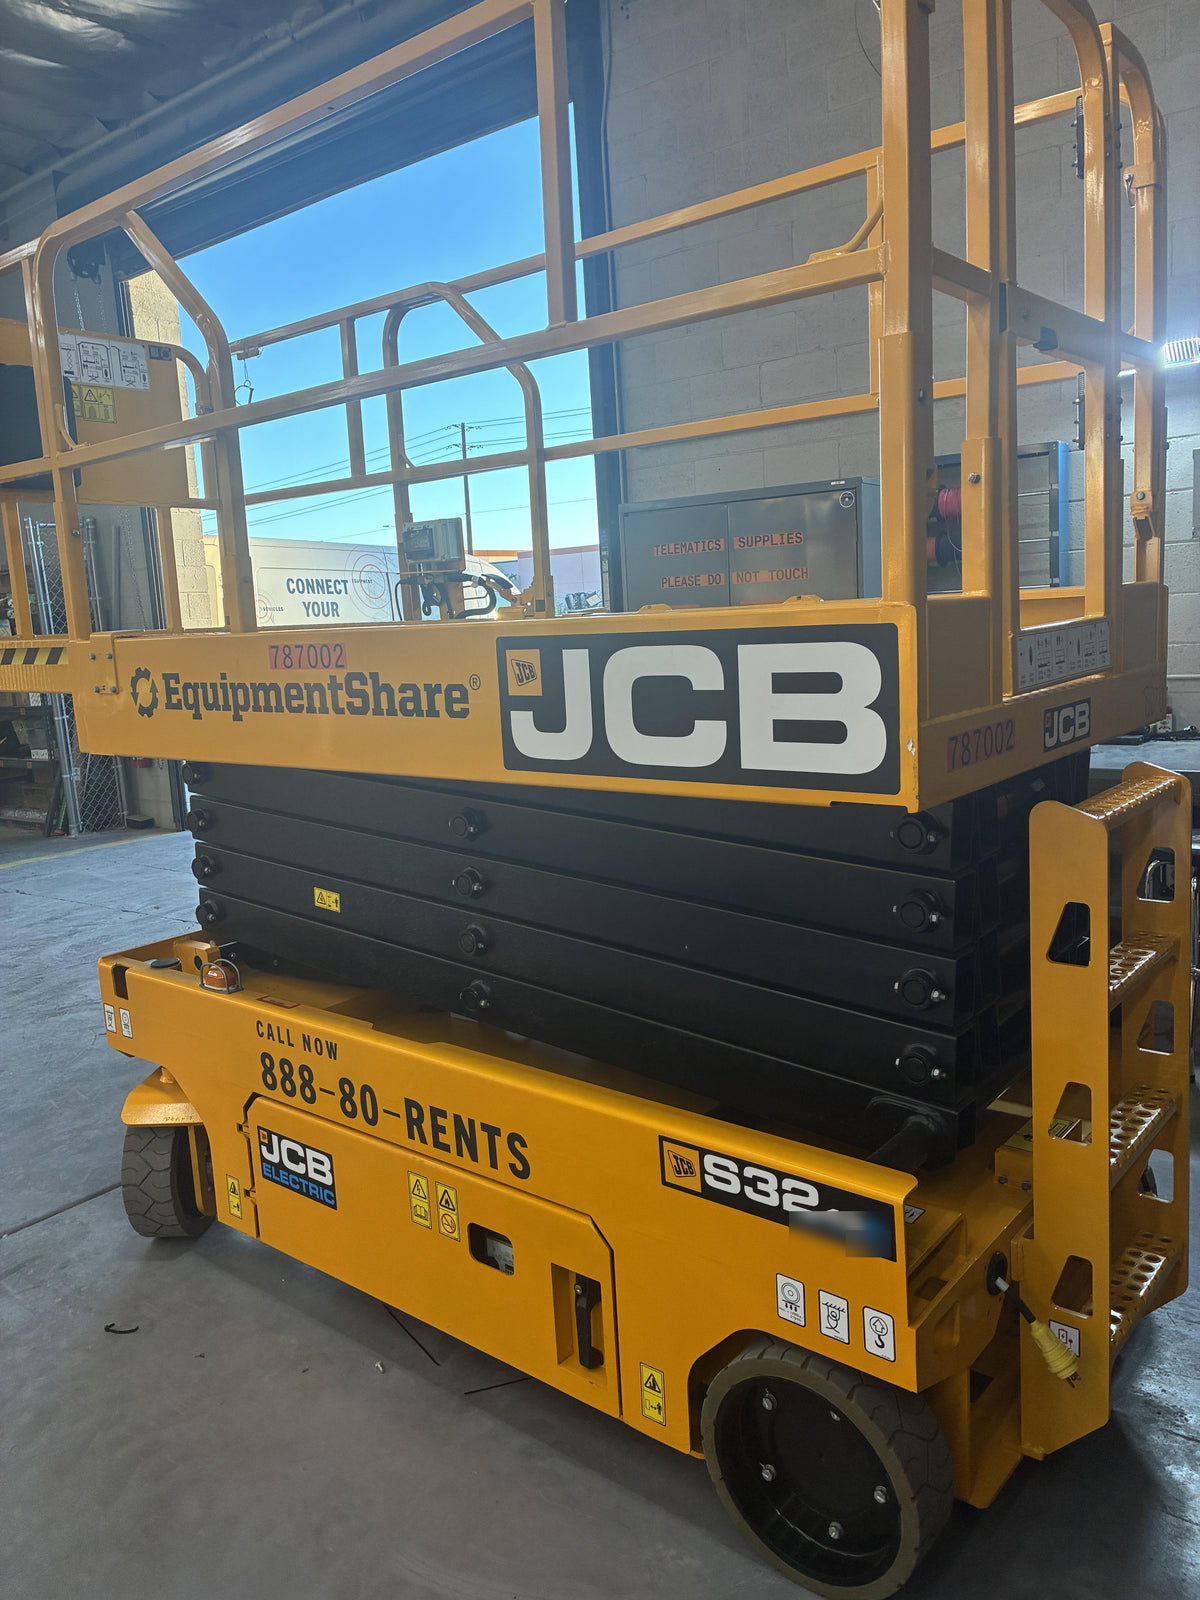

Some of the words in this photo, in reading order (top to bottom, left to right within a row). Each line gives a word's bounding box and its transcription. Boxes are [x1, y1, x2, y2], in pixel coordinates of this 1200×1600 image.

[654, 539, 721, 556] TELEMATICS
[738, 532, 803, 549] SUPPLIES
[286, 578, 349, 595] CONNECT
[661, 576, 701, 588] PLEASE
[708, 573, 722, 585] DO
[736, 571, 760, 583] NOT
[768, 567, 809, 581] TOUCH
[302, 601, 340, 617] YOUR
[270, 643, 345, 669] 787002
[515, 659, 537, 684] JCB
[510, 641, 887, 775] JCB
[1045, 702, 1090, 748] JCB
[948, 719, 1015, 769] 787002
[256, 1020, 295, 1048] CALL
[302, 1033, 338, 1061] NOW
[260, 1051, 531, 1180] 888-80-RENTS
[261, 1133, 333, 1186] JCB
[672, 1153, 695, 1176] JCB
[262, 1162, 335, 1205] ELECTRIC
[703, 1154, 839, 1213] S32
